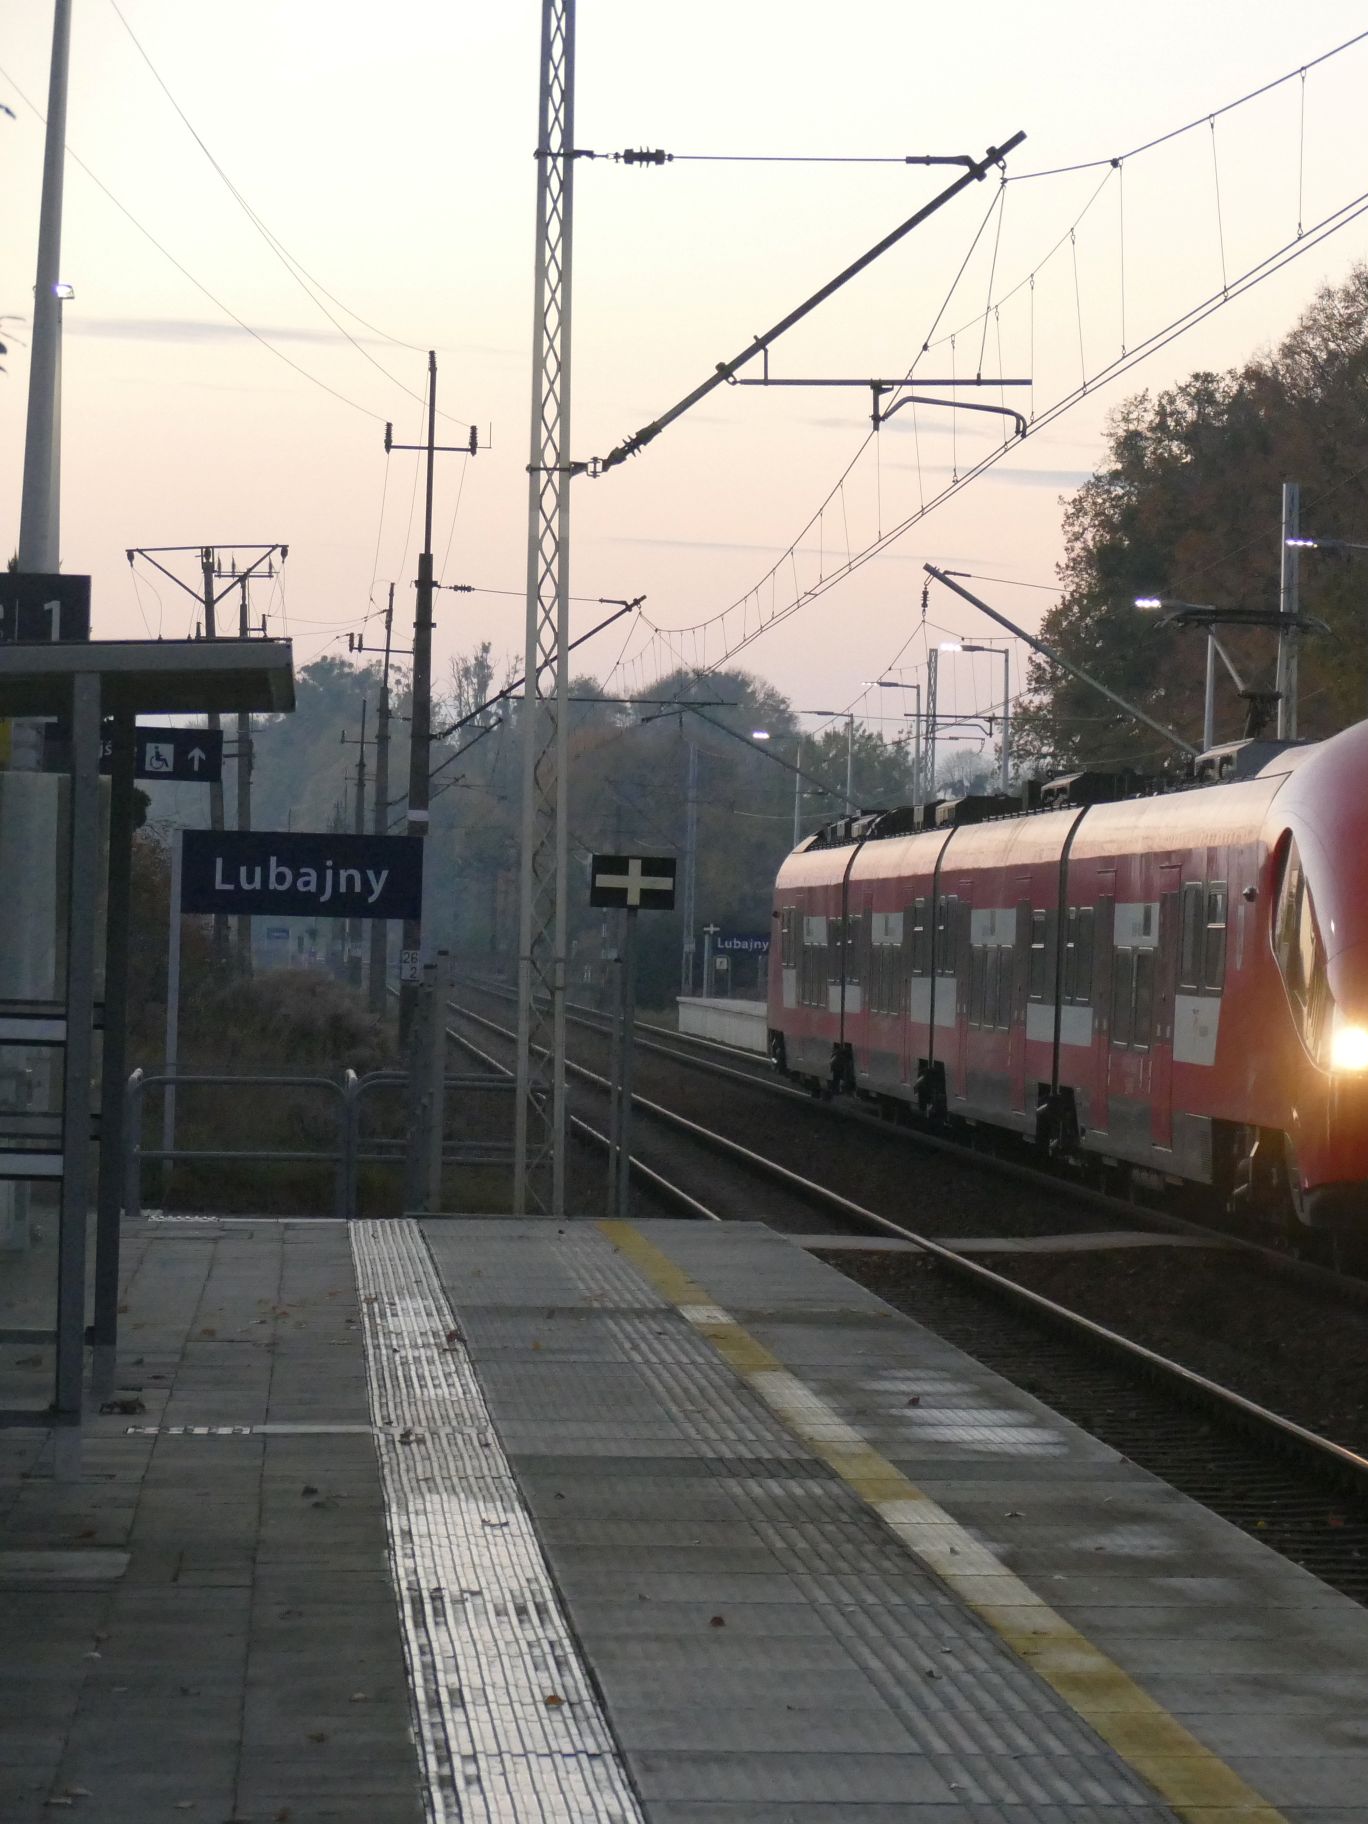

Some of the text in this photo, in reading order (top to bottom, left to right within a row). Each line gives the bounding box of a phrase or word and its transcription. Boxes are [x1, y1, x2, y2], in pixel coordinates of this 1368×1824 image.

[43, 600, 60, 641] 1
[215, 856, 389, 903] Lubajny
[717, 937, 769, 952] Lubajny
